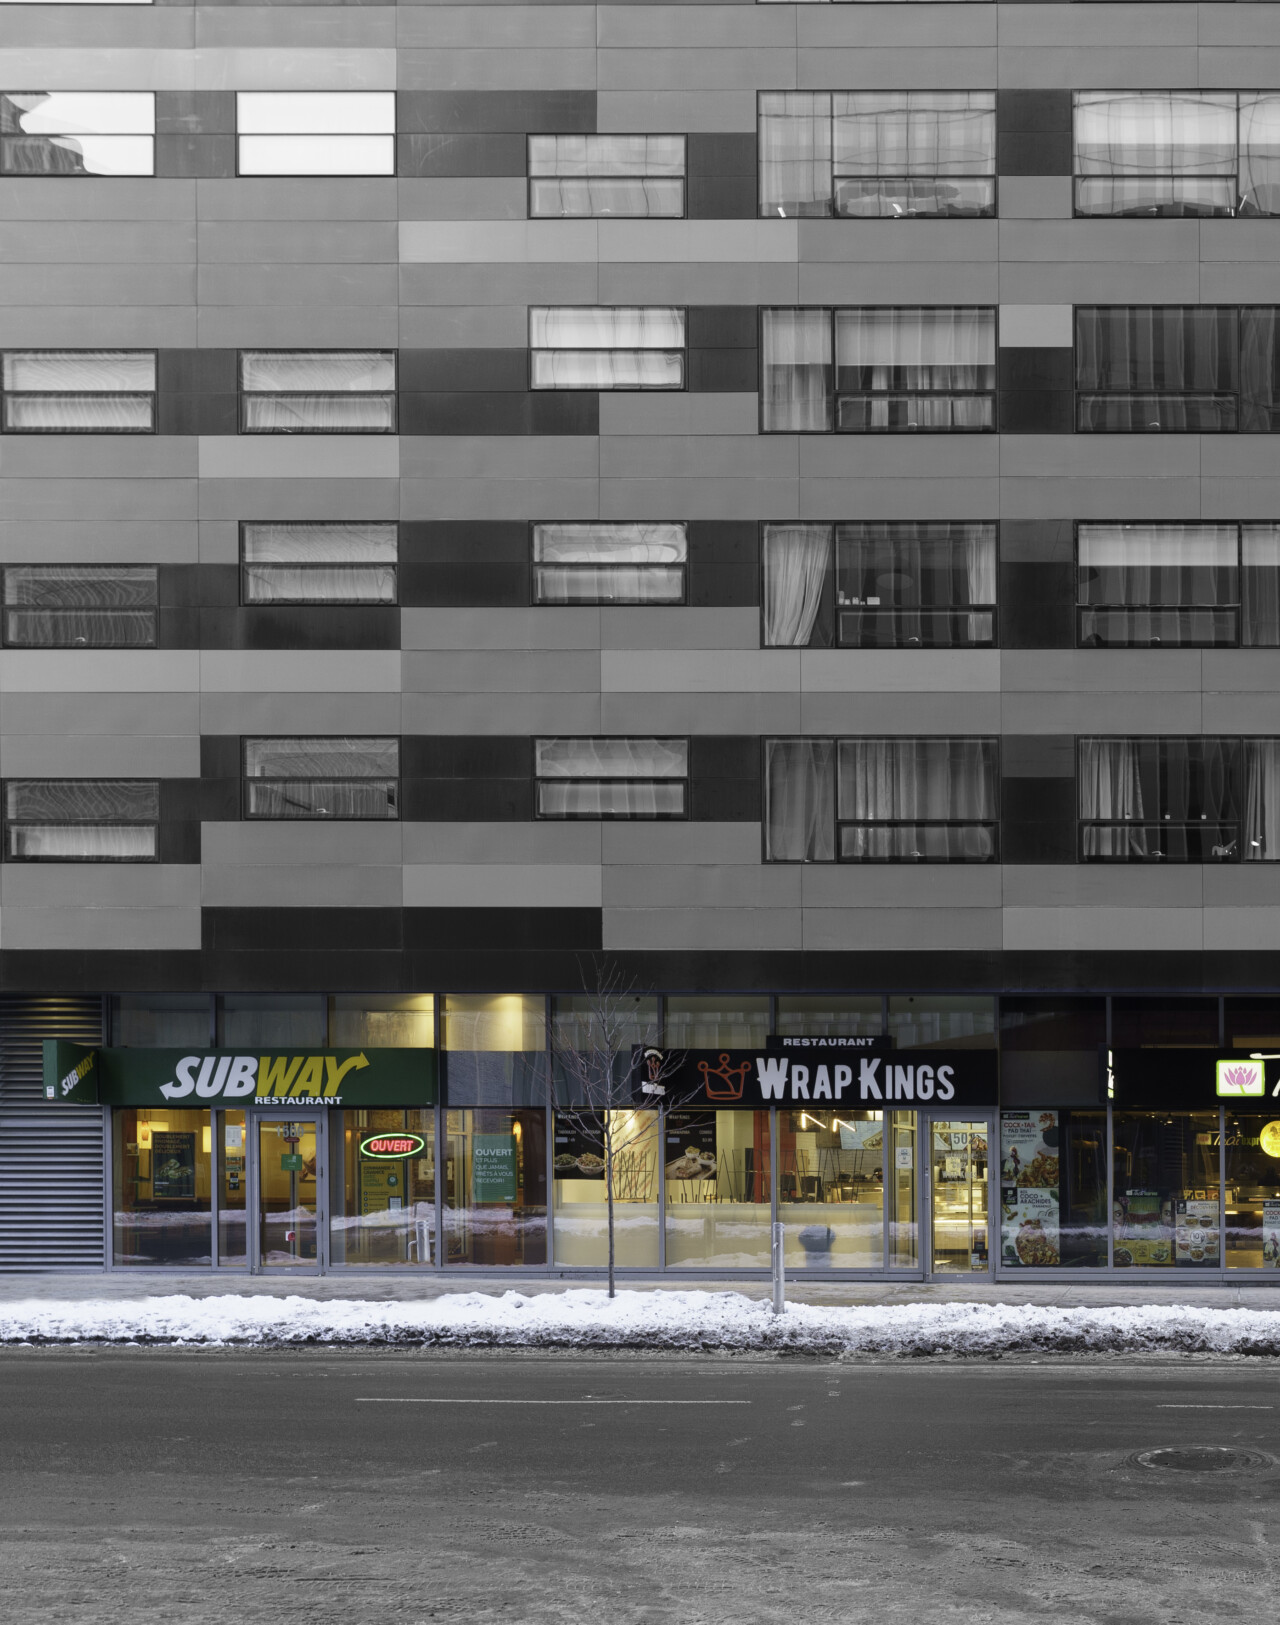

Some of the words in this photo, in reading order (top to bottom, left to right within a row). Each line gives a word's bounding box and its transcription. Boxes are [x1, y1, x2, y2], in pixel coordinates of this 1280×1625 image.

[783, 1038, 875, 1047] RESTAURANT
[62, 1051, 95, 1097] SUBWAY
[159, 1051, 370, 1100] SUBWAY
[757, 1057, 852, 1100] WRAP
[858, 1057, 955, 1100] KINGS
[254, 1096, 342, 1105] RESTAURANT
[370, 1139, 414, 1152] OUVERT
[475, 1148, 513, 1156] OUVERT
